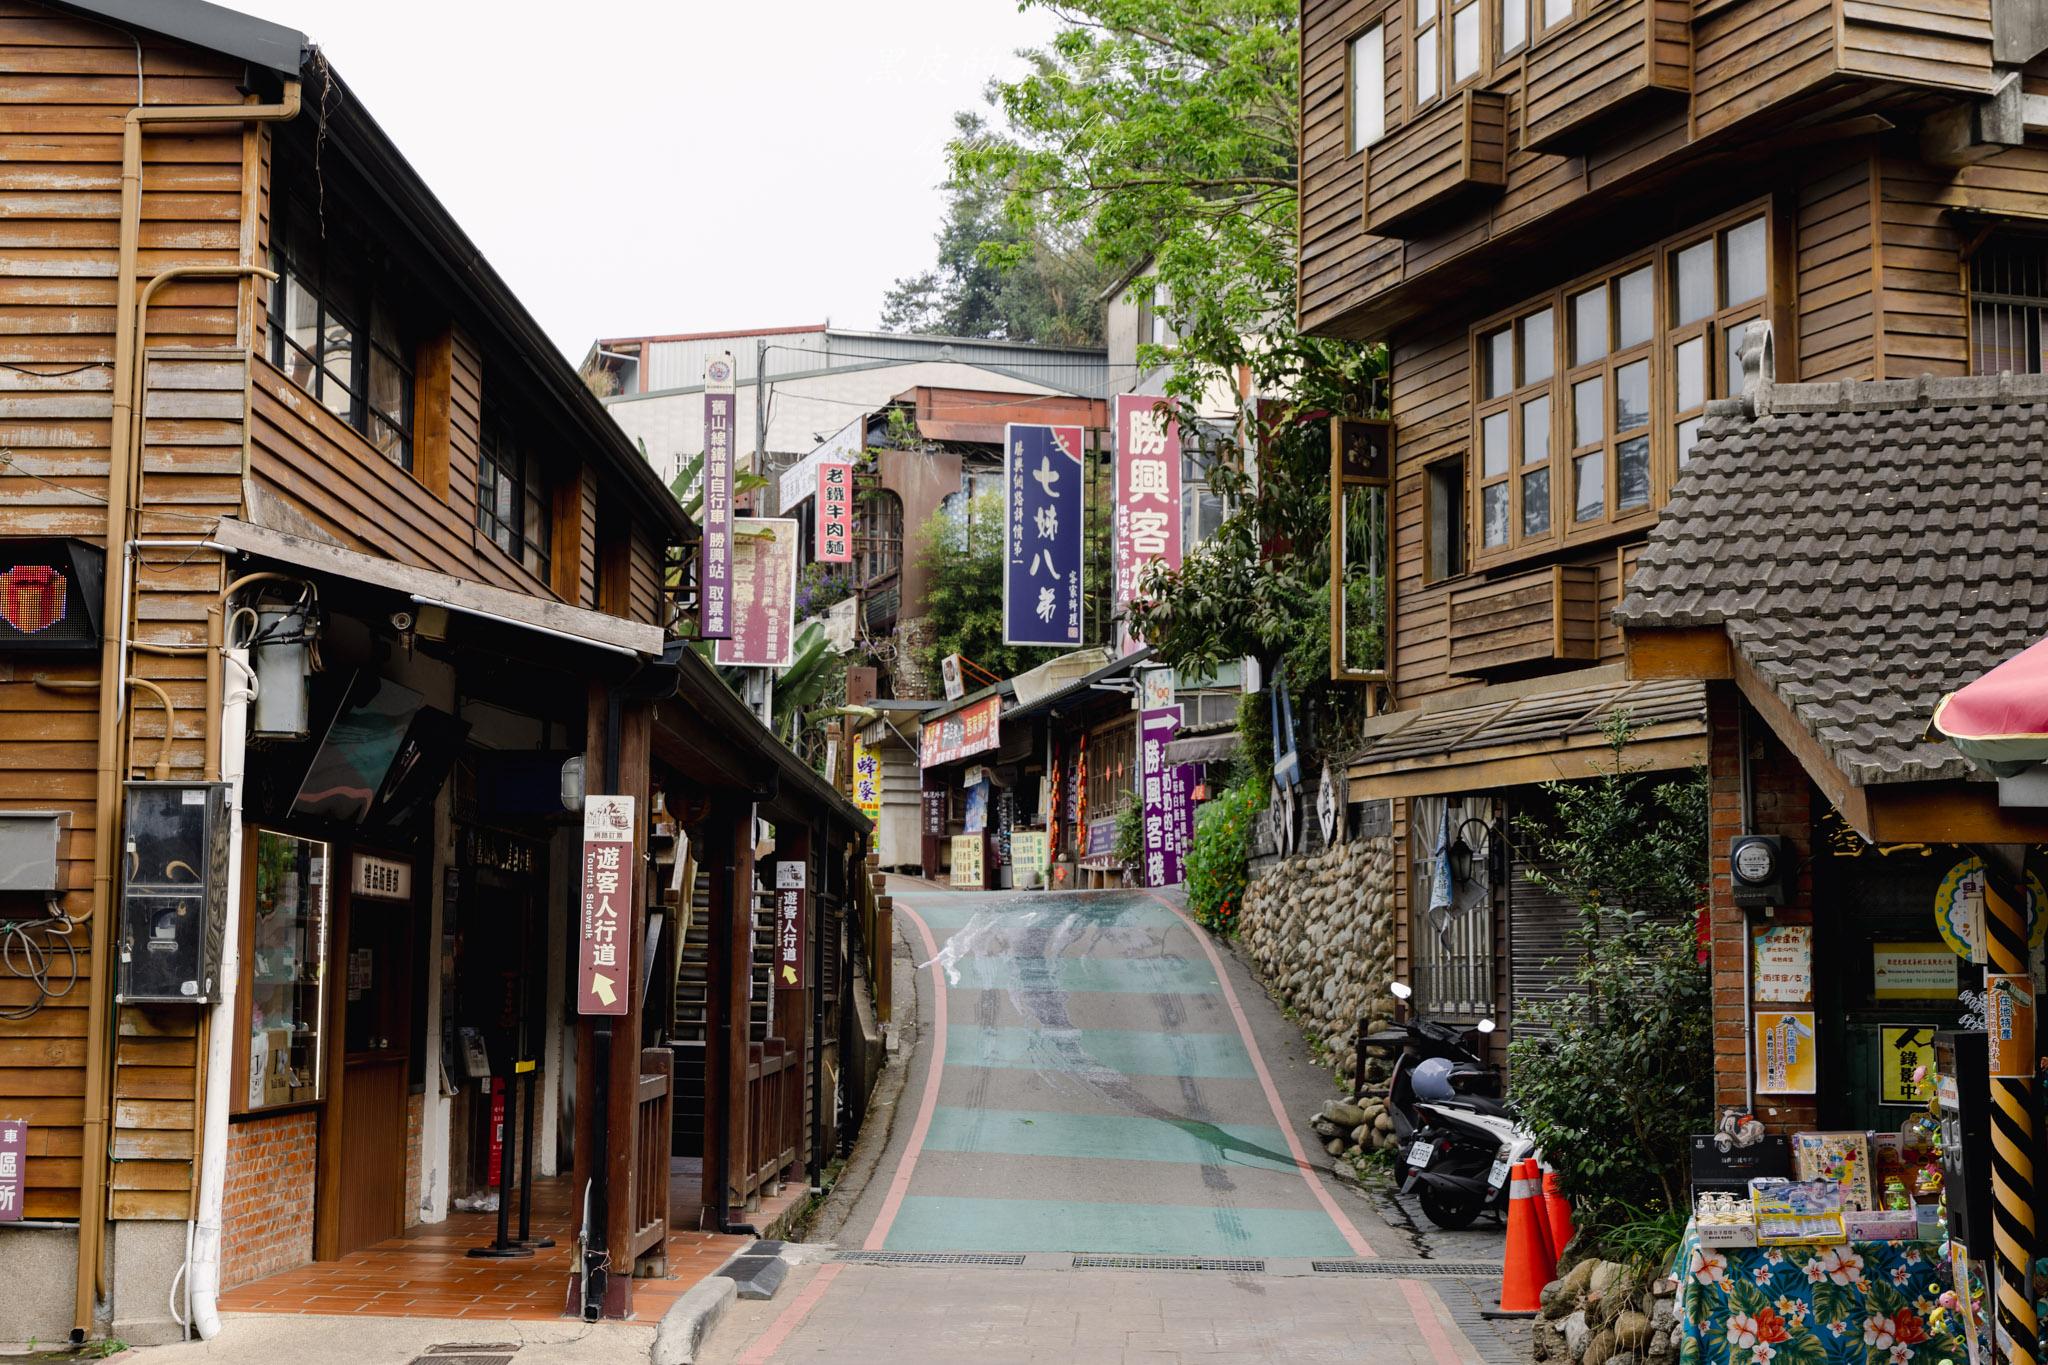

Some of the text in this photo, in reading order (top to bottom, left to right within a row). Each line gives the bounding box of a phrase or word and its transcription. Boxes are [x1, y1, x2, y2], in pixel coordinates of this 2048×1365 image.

[710, 400, 727, 523] 舊山線鐵道自行車
[826, 469, 845, 556] 老鐵牛肉麵
[708, 532, 726, 579] 勝興站
[1030, 455, 1061, 624] 七姊八弟
[707, 586, 726, 632] 取票處
[1068, 570, 1079, 627] 客家料理
[856, 756, 877, 803] 蜂蜜
[594, 831, 623, 840] 網路訂票
[1144, 738, 1165, 886] 勝興客棧
[585, 851, 596, 939] Tourist Sidewalk
[593, 848, 619, 966] 遊客人行道
[782, 891, 797, 962] 遊客人行道
[1999, 997, 2011, 1039] 在地特產
[1788, 1029, 1796, 1064] 在地特產
[1900, 1051, 1917, 1100] 錄影中
[4, 1129, 18, 1143] 車
